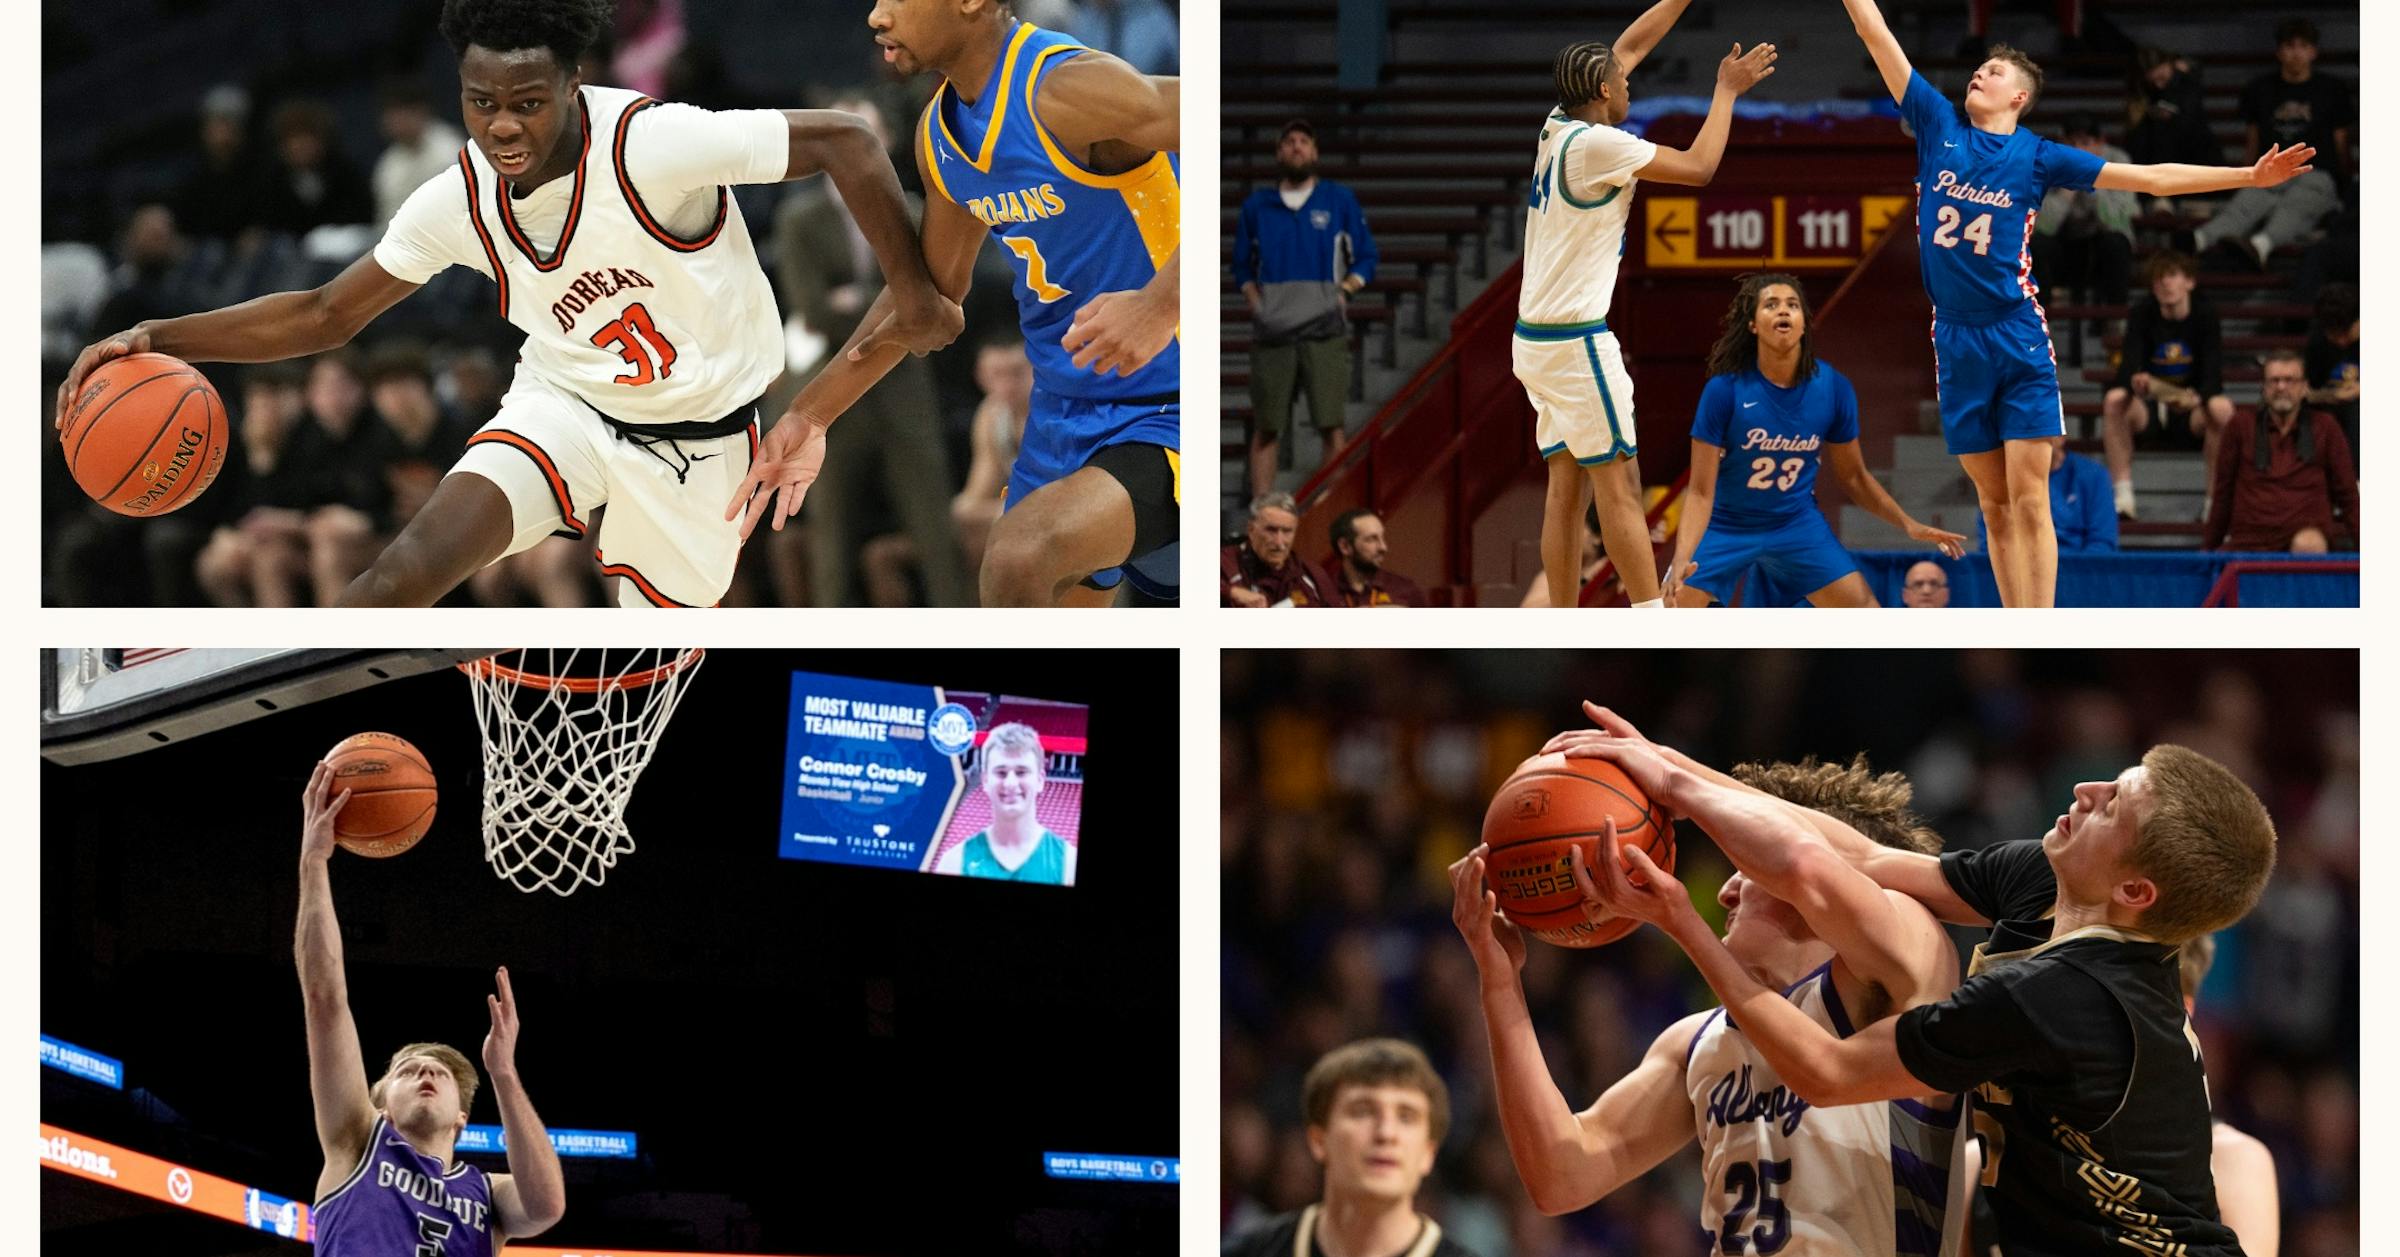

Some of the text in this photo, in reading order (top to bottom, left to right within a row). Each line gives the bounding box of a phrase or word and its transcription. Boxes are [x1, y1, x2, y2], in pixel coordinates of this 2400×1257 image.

[1932, 169, 2013, 208] Patriots
[1706, 209, 1764, 249] 110
[1797, 209, 1849, 249] 111
[1933, 205, 1993, 256] 24
[124, 427, 204, 513] SPALDING
[1746, 456, 1806, 493] 23
[803, 714, 888, 742] TEAMMATE
[804, 695, 926, 727] MOST VALUABLE
[799, 755, 864, 778] Connor
[866, 762, 927, 787] Crosby
[846, 835, 916, 853] TRUSTONE
[558, 1134, 628, 1149] BASKETBALL
[1719, 1157, 1793, 1257] 25
[415, 1211, 453, 1257] 5
